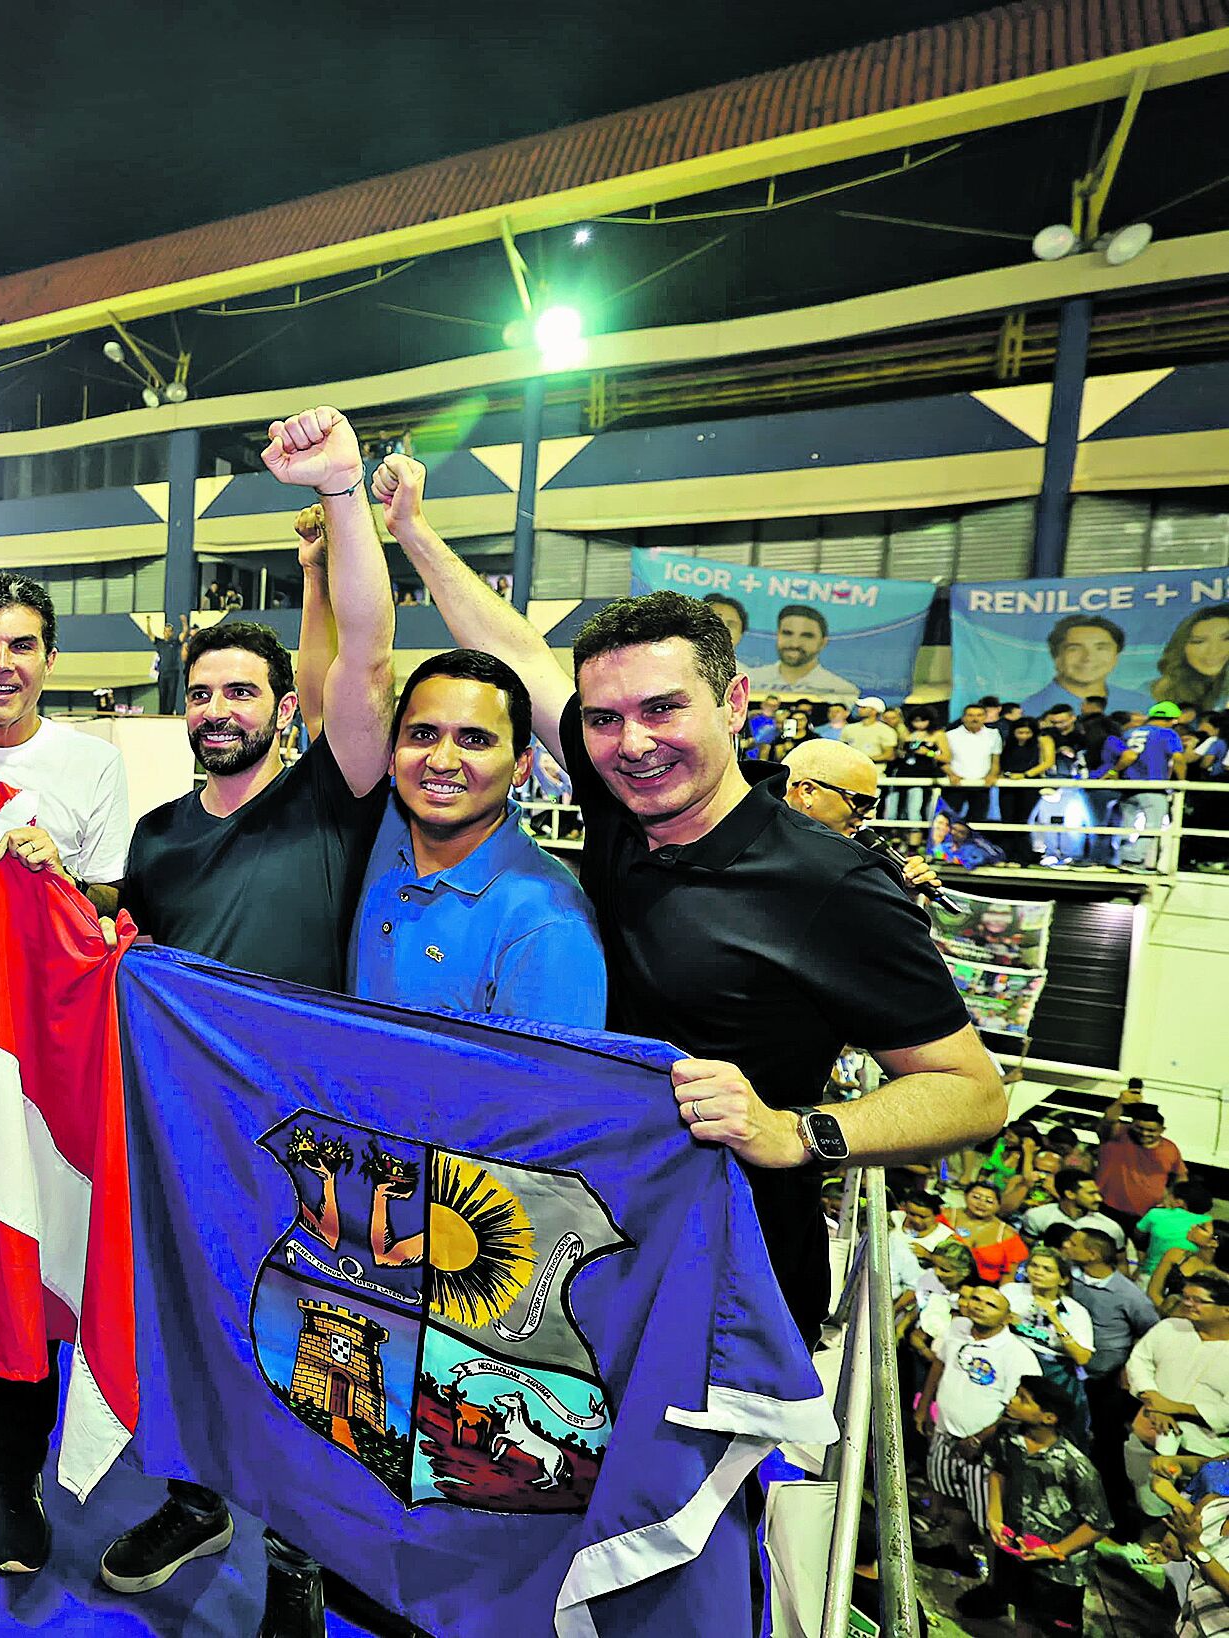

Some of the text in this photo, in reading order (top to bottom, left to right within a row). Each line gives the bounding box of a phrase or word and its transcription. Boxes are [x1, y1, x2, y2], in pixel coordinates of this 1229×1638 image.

[664, 561, 732, 590] IGOR
[737, 573, 762, 594] +
[969, 576, 1229, 614] RENILCE + N
[537, 1282, 548, 1297] CUM
[566, 1414, 586, 1426] EST
